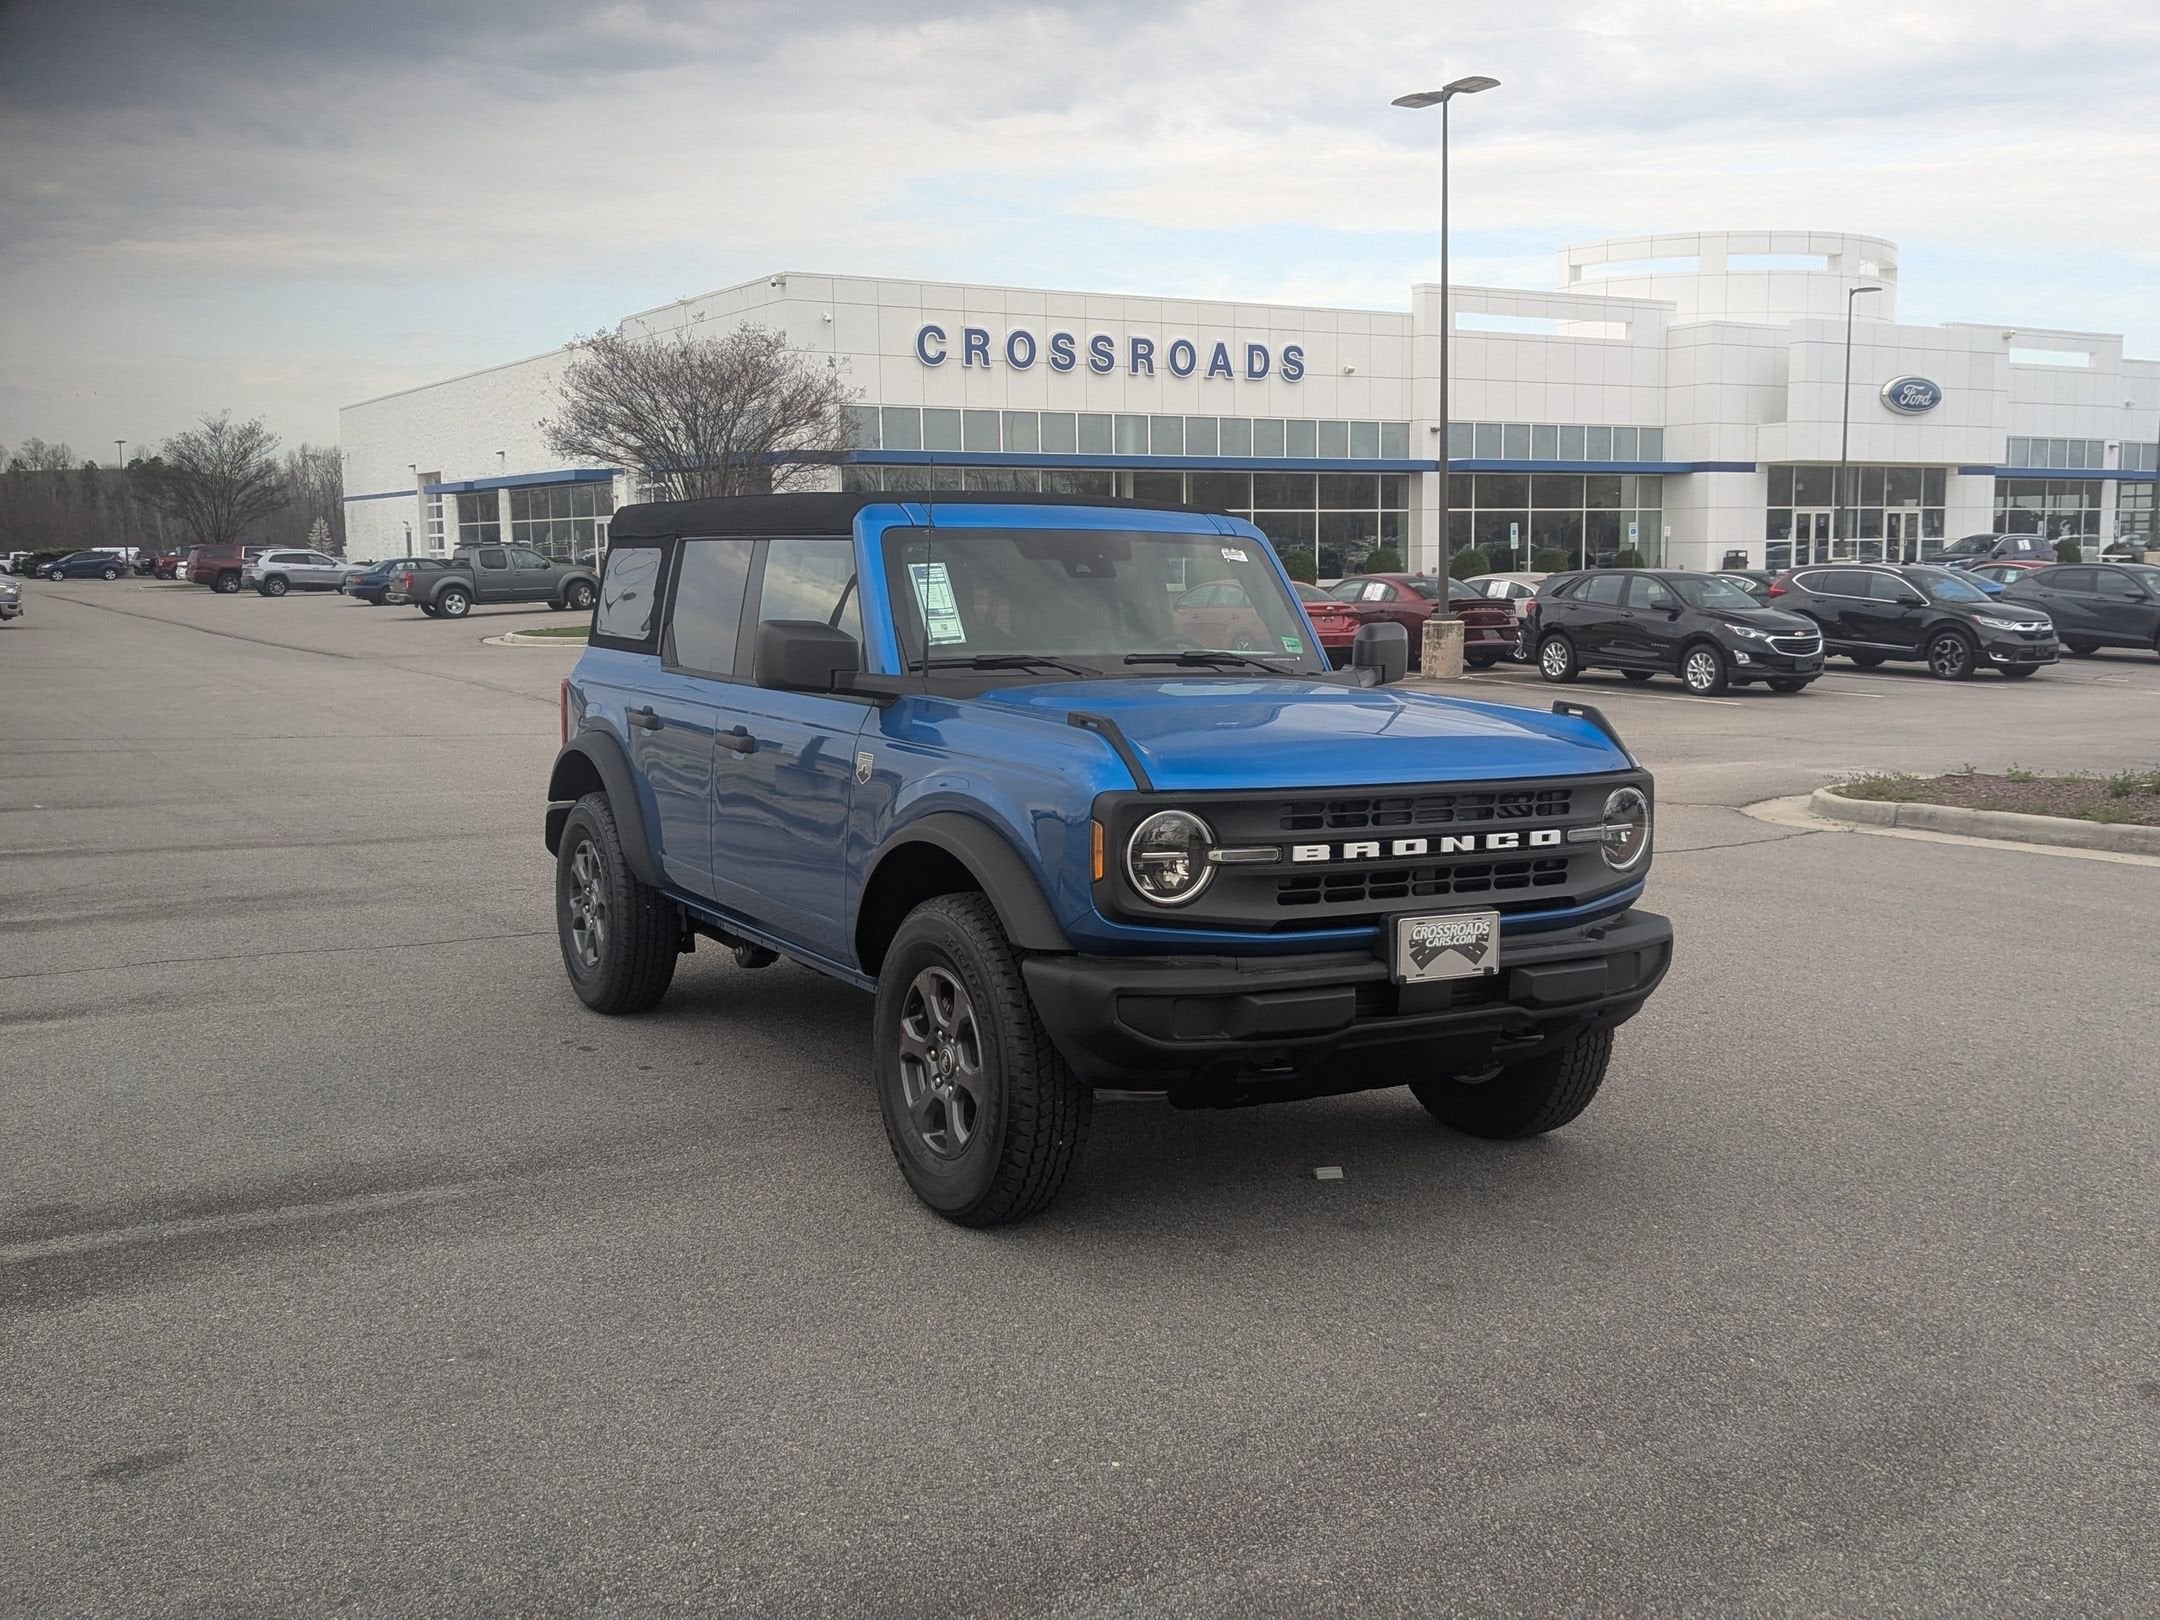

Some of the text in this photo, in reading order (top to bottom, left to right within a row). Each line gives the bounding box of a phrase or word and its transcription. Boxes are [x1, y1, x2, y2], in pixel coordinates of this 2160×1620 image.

[916, 323, 1306, 383] CROSSROADS
[1900, 384, 1933, 405] Ford
[1292, 829, 1561, 862] BRONCO
[1411, 920, 1491, 941] CROSSROADS
[1425, 934, 1477, 947] CARS.COM
